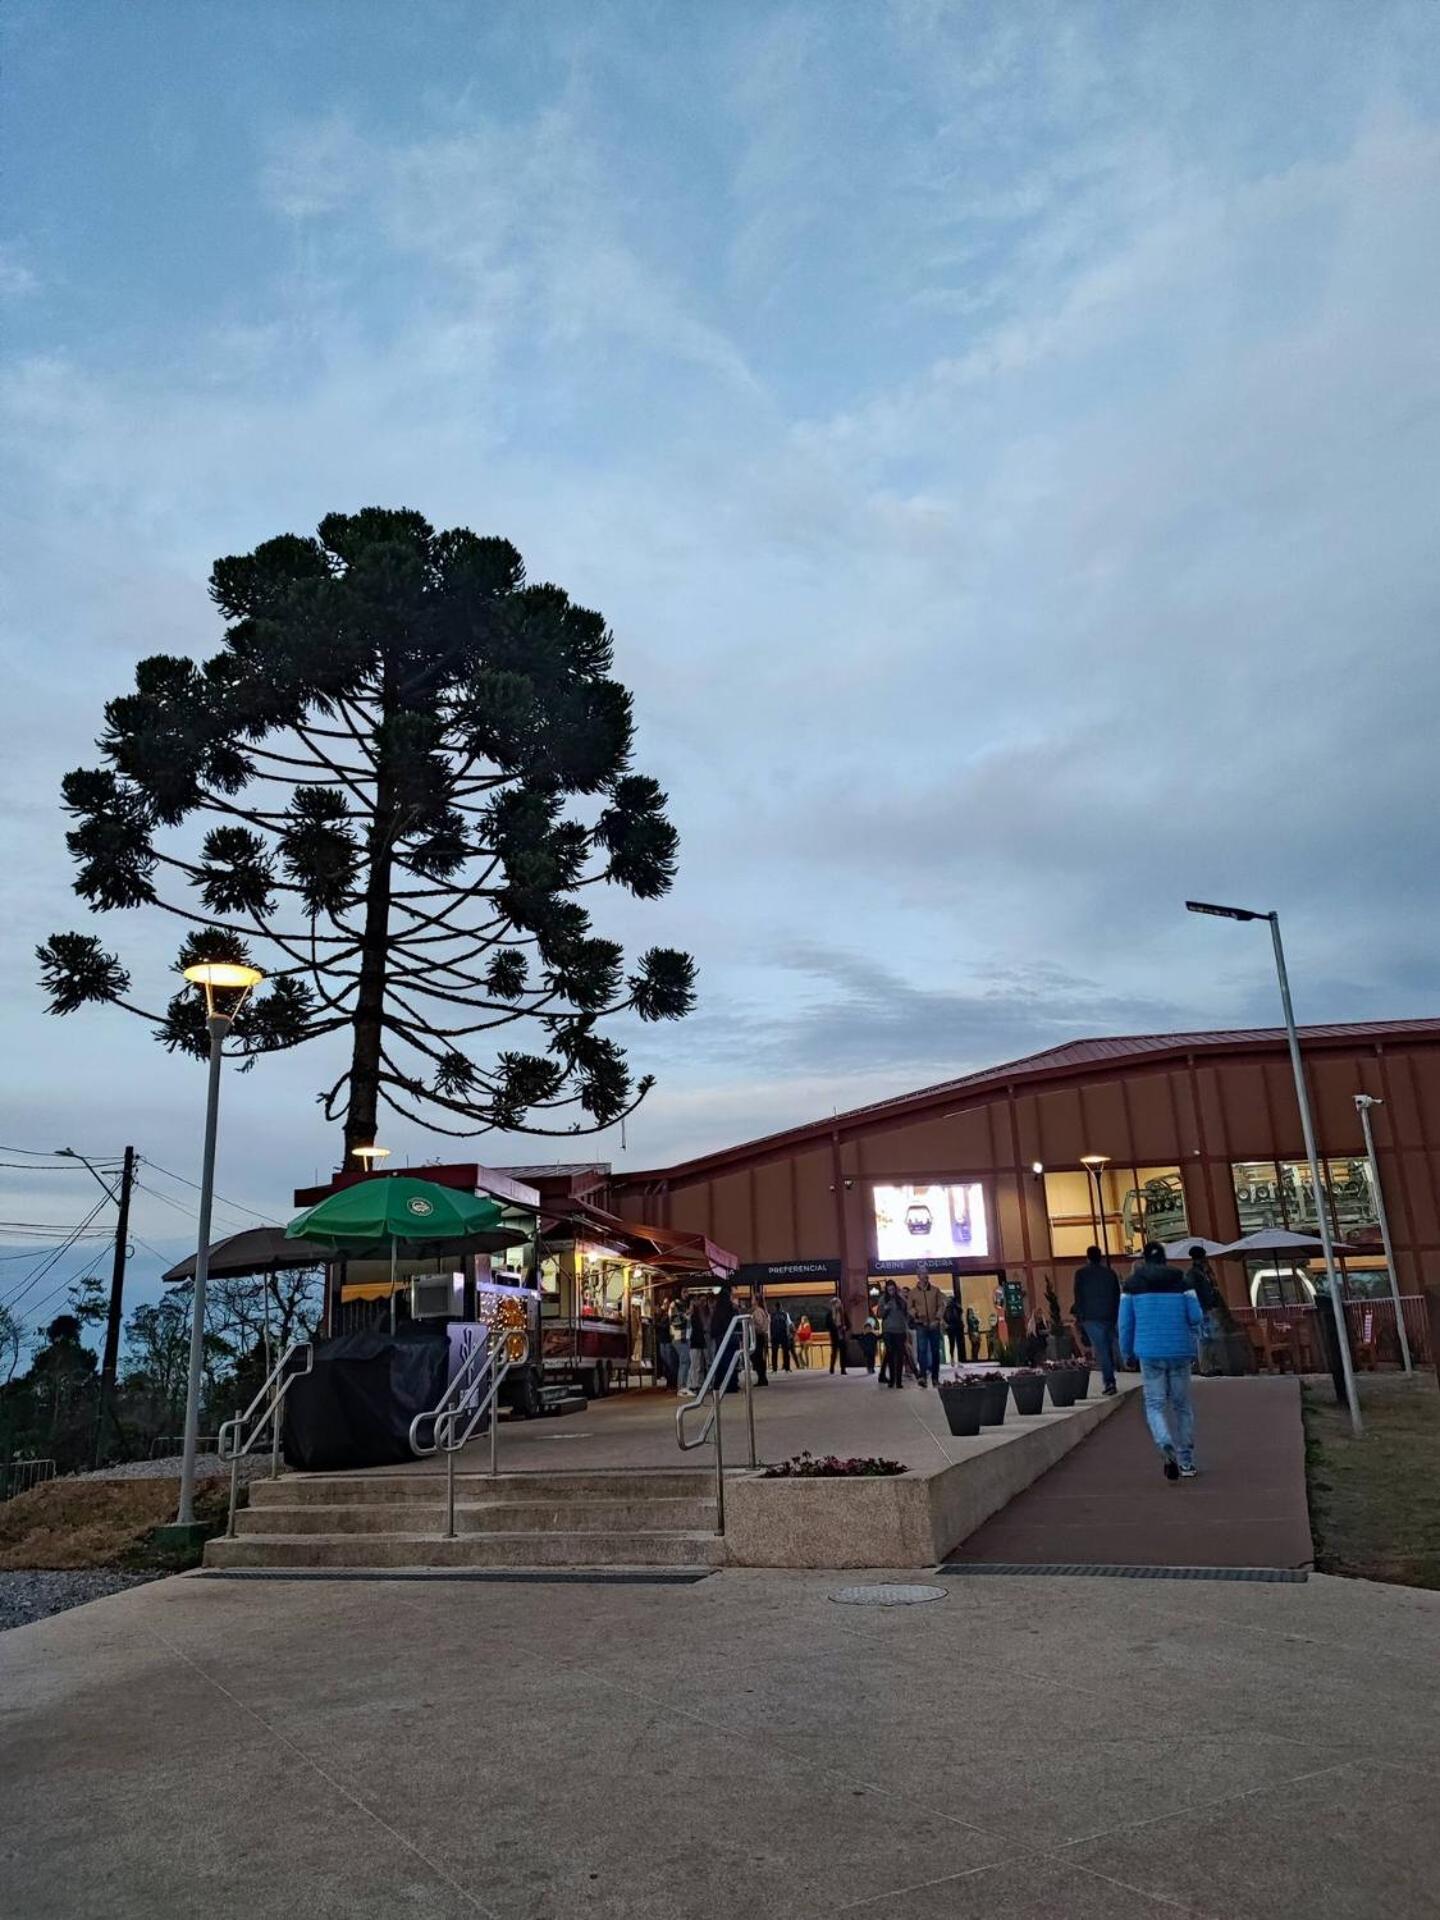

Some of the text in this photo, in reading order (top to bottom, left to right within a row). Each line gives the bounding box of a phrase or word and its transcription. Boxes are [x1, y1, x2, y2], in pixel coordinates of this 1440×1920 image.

[768, 1264, 827, 1274] PREFERENCIAL
[874, 1261, 905, 1271] CABINE
[916, 1259, 953, 1269] CADEIRA
